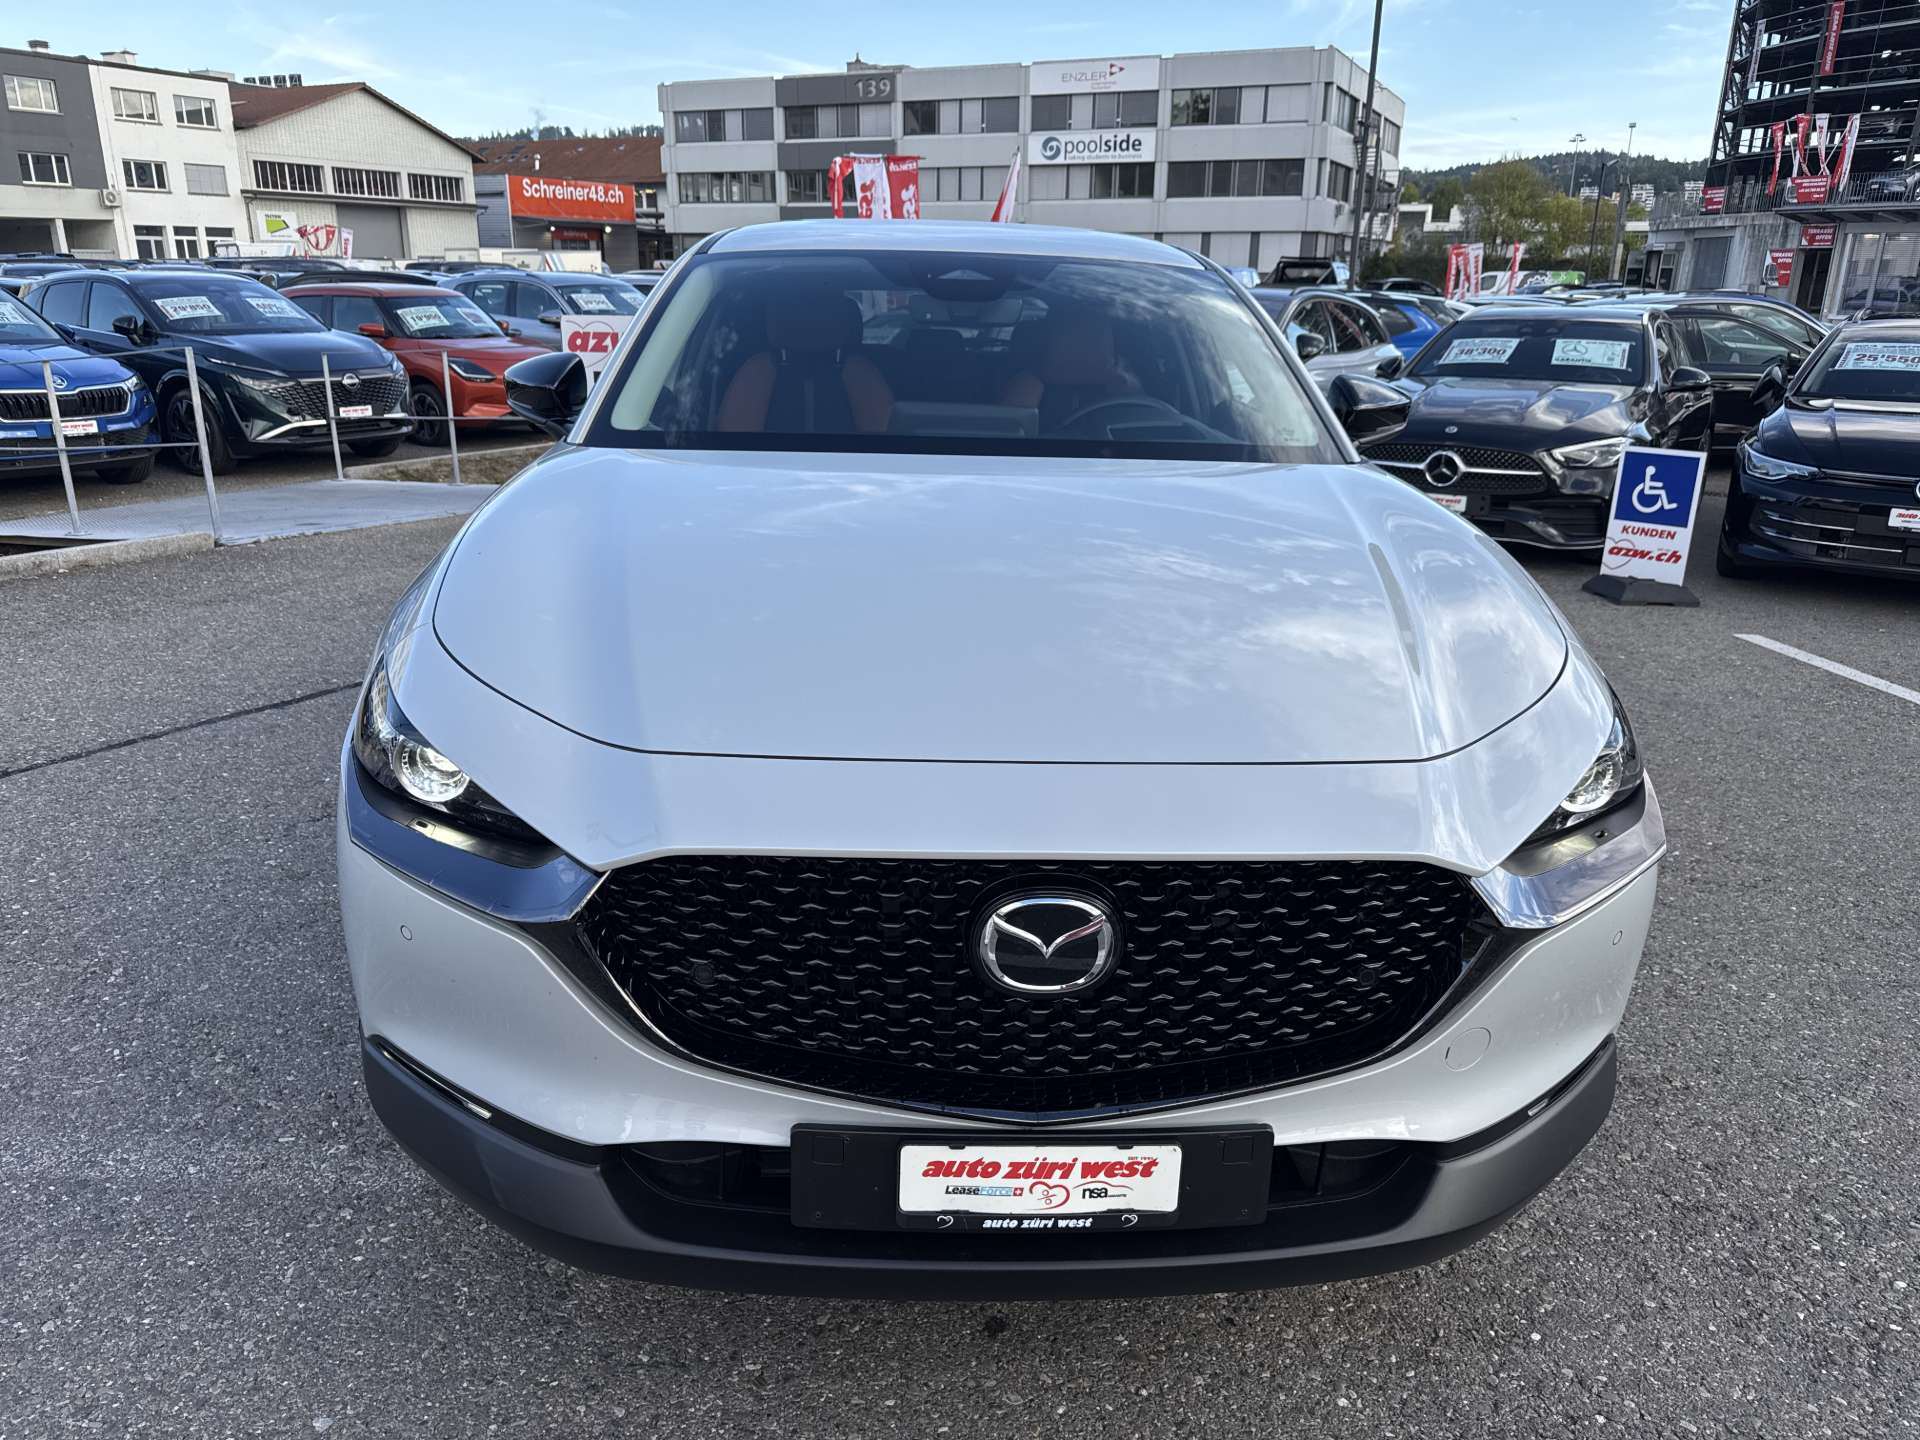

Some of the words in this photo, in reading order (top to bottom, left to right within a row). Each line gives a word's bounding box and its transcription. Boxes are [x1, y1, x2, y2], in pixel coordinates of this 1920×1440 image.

[1061, 71, 1108, 82] ENZLER
[856, 79, 891, 98] 139
[1064, 133, 1142, 161] poolside
[522, 177, 624, 204] Schreiner48.ch
[1621, 525, 1677, 540] KUNDEN
[1608, 546, 1682, 564] azw.ch
[921, 1157, 1002, 1179] auto
[1002, 1157, 1079, 1180] züri
[1080, 1158, 1159, 1179] west
[944, 1185, 1012, 1196] LeaseForce
[1082, 1187, 1108, 1199] nsa
[982, 1218, 1018, 1229] auto
[1020, 1217, 1054, 1229] züri
[1056, 1217, 1093, 1228] west
